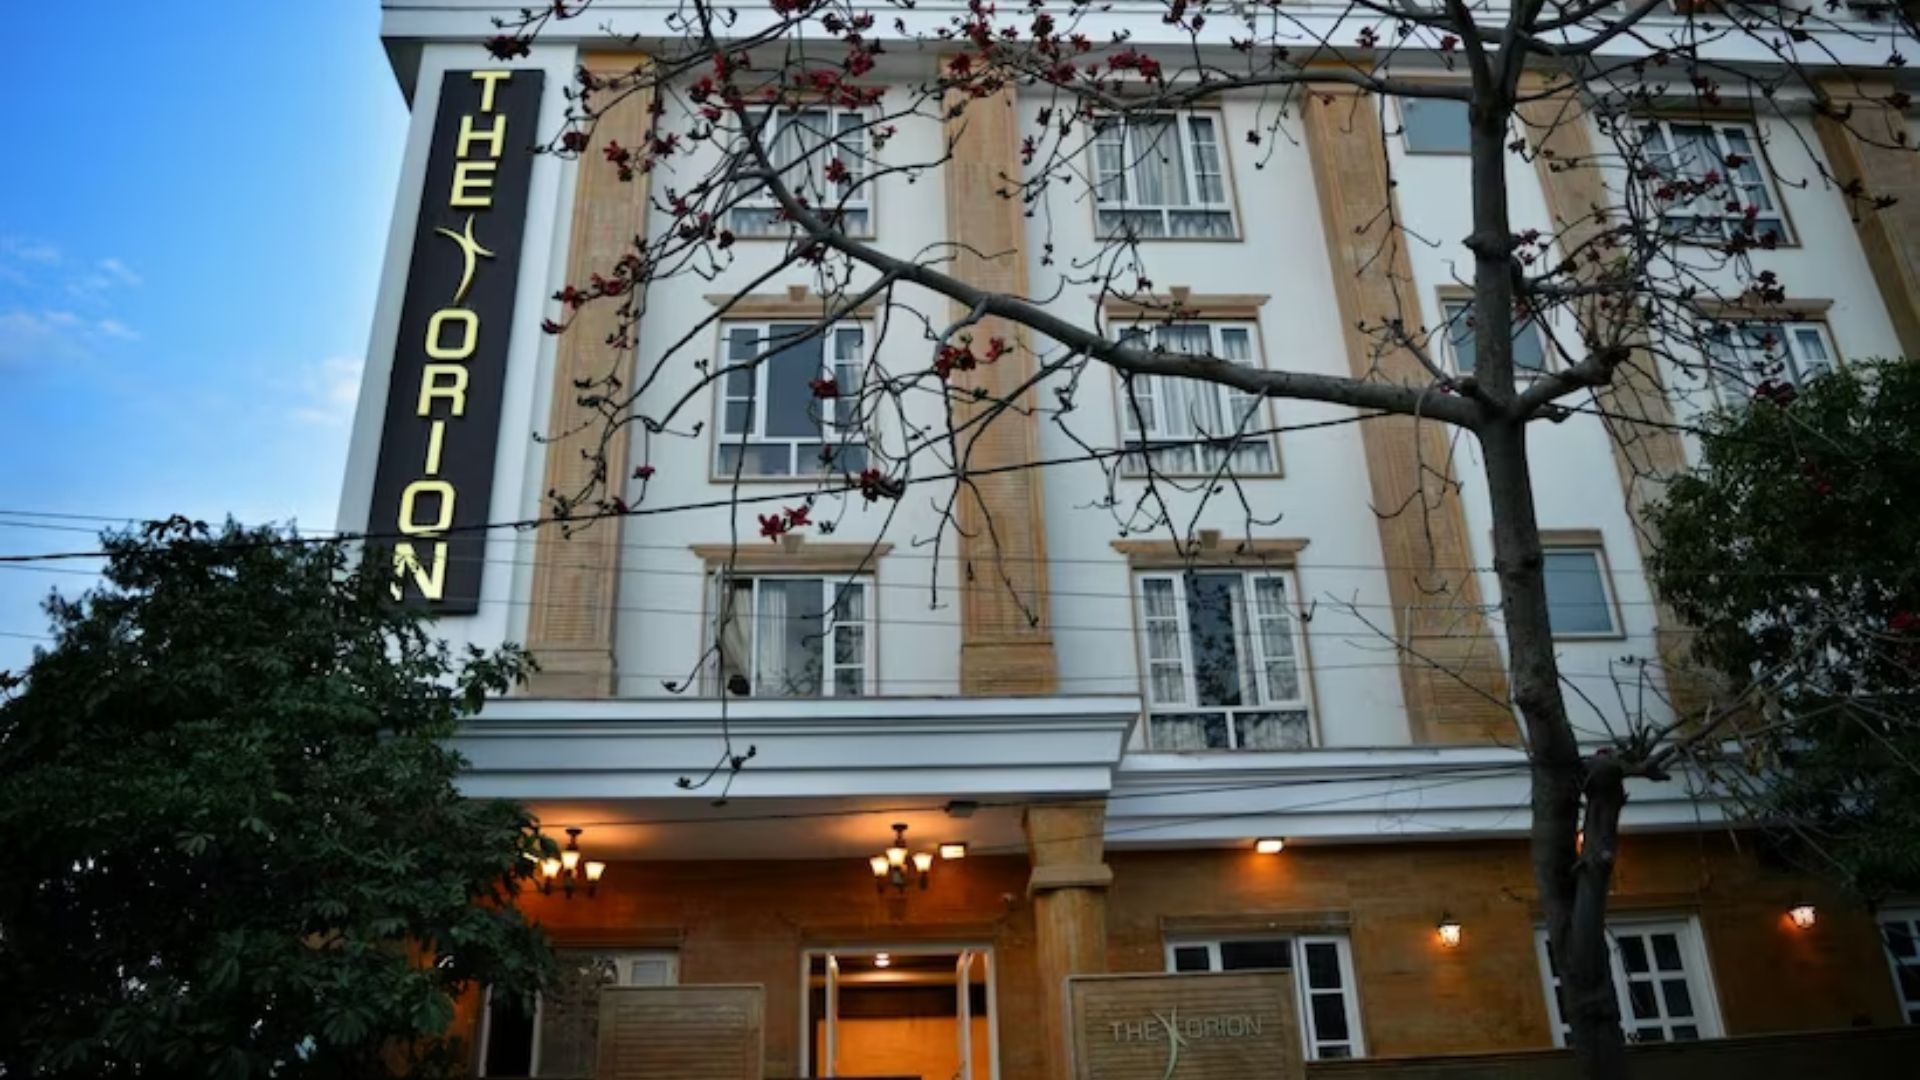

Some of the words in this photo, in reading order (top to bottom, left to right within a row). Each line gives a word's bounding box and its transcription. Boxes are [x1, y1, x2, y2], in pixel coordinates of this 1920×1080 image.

[450, 70, 511, 206] THE
[390, 308, 480, 601] ORION
[1109, 1019, 1158, 1042] THE
[1185, 1013, 1263, 1038] ORION
